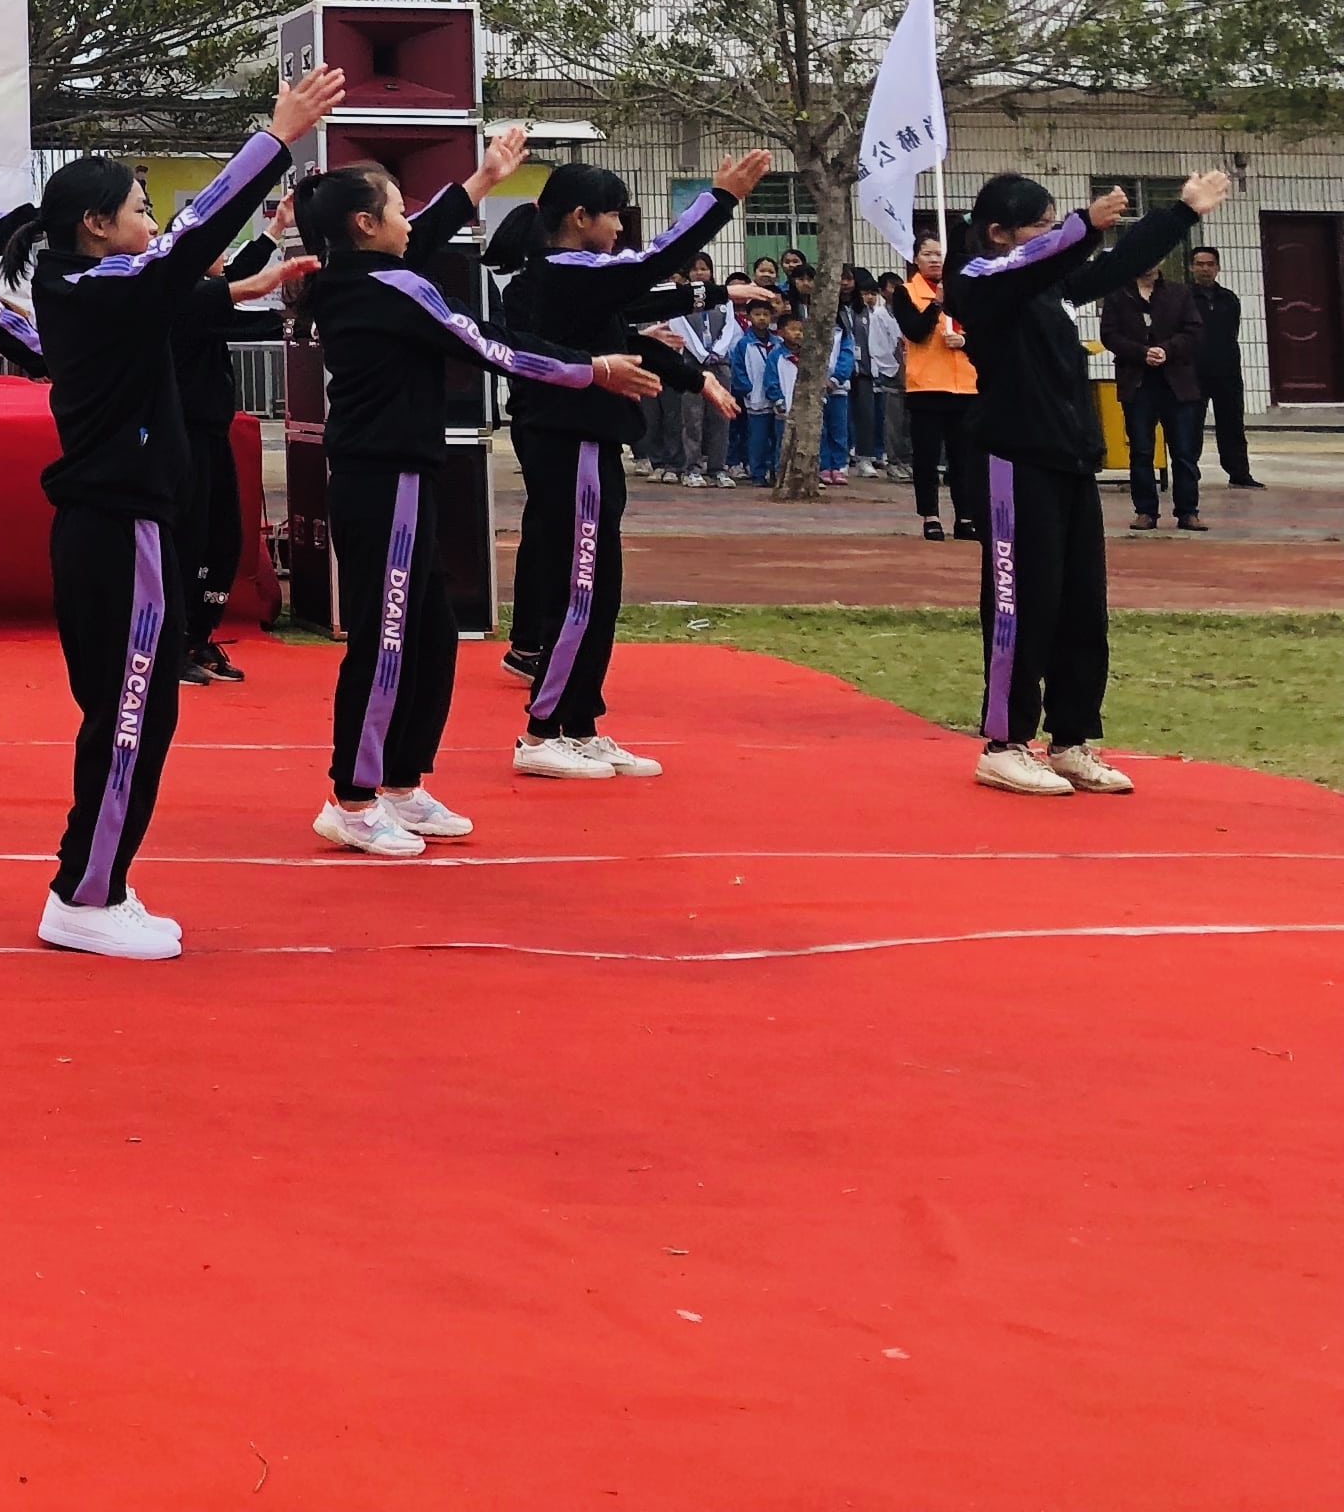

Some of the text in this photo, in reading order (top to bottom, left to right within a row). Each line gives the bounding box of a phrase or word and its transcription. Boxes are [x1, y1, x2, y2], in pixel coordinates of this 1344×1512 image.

[450, 315, 515, 366] DCANE
[576, 523, 596, 592] DCANE
[996, 540, 1016, 615] DCANE
[383, 569, 408, 653] DCANE
[117, 652, 151, 751] DCANE
